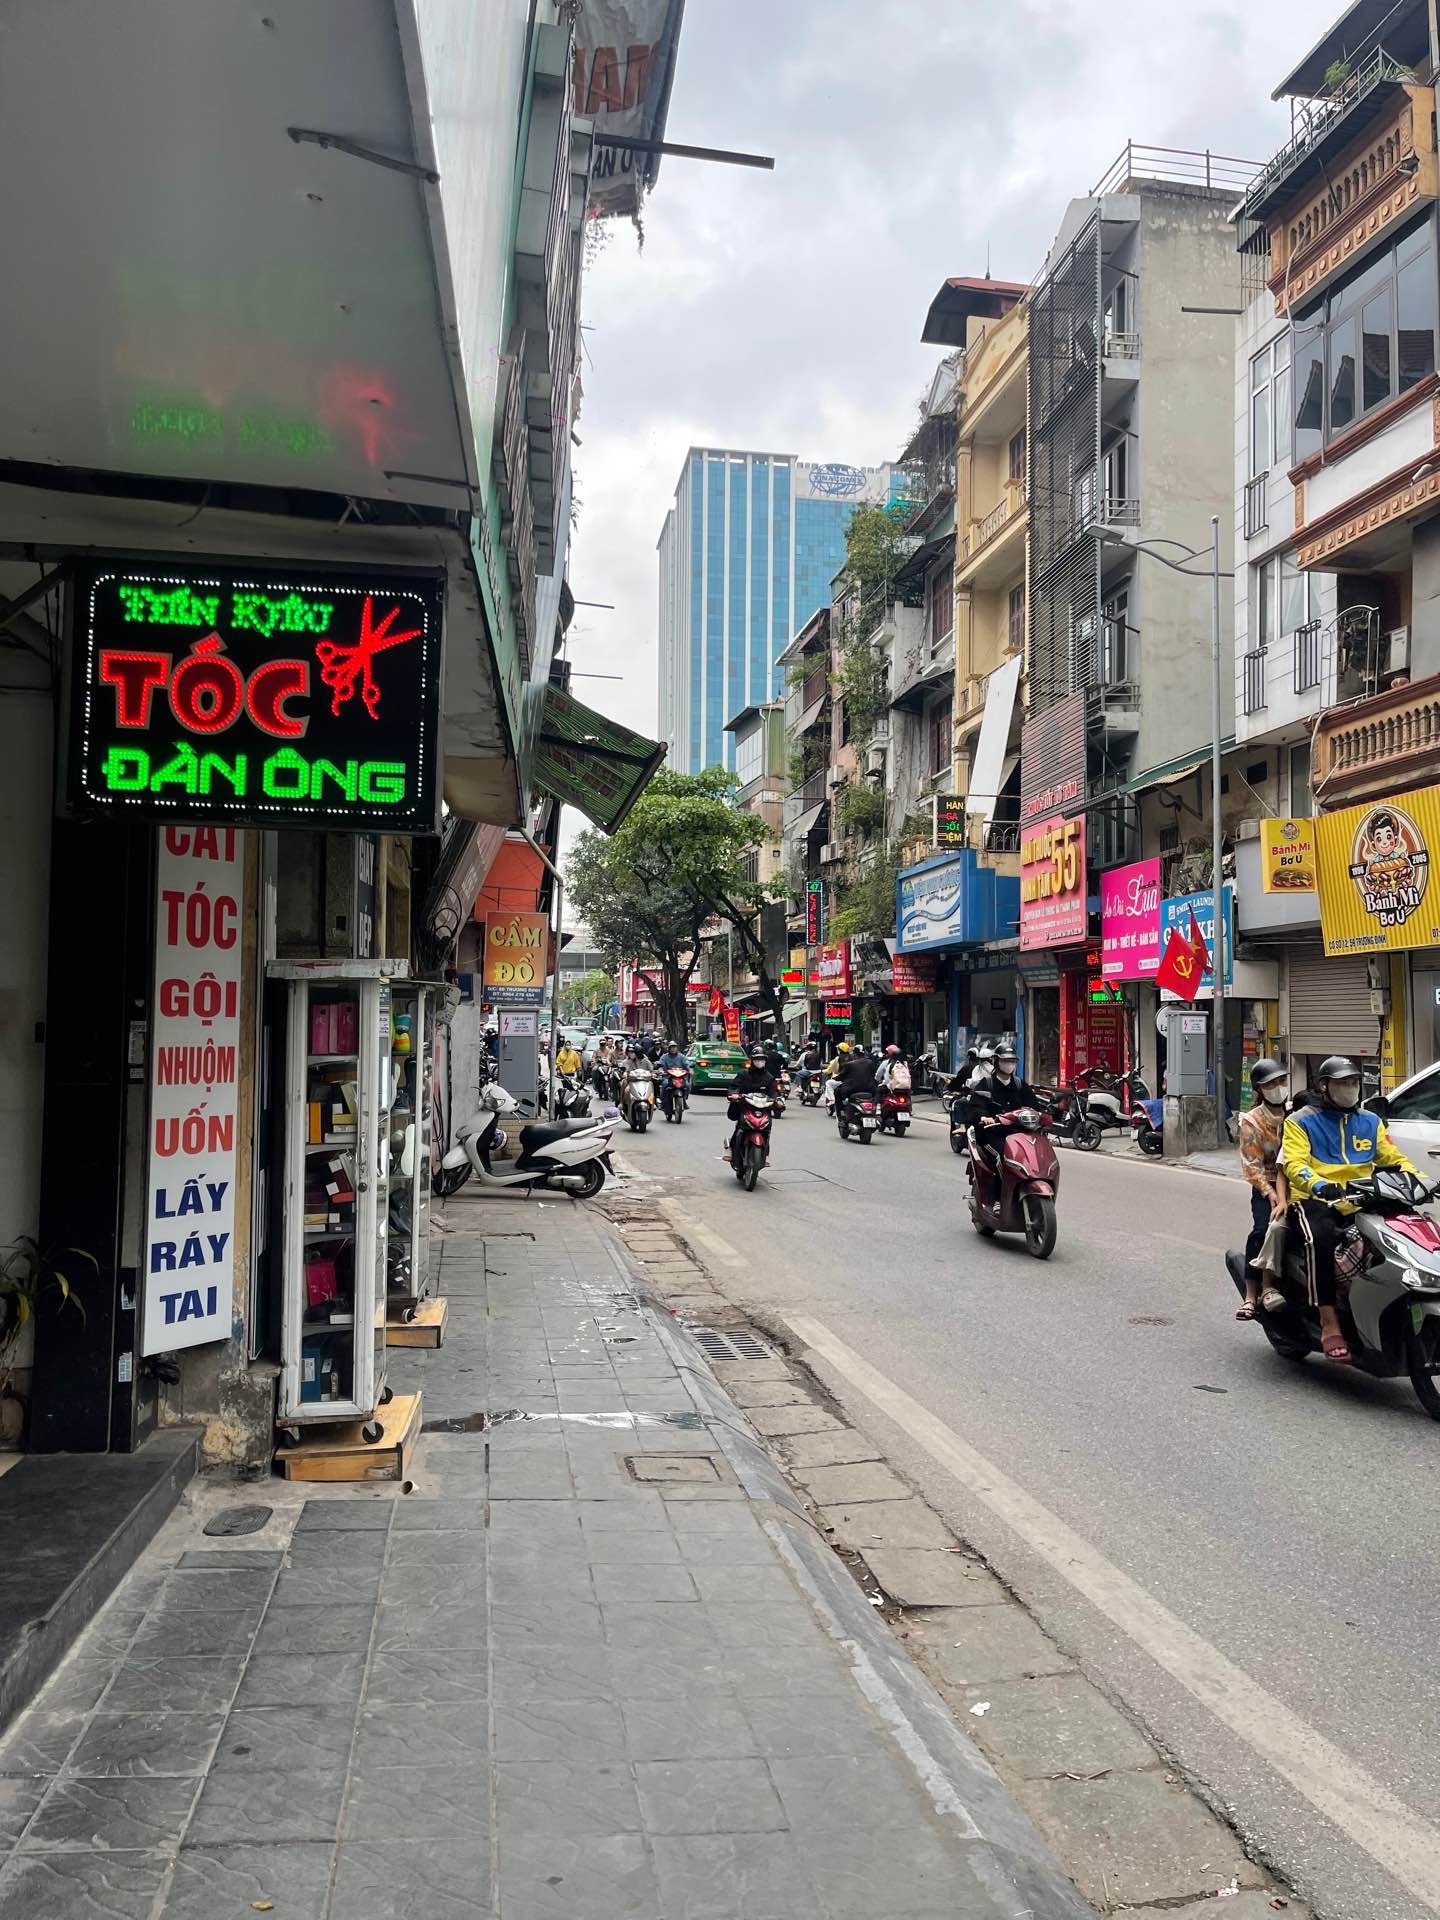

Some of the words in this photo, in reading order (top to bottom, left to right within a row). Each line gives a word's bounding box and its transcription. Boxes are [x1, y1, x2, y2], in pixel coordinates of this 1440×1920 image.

[99, 630, 310, 739] TÓC
[102, 741, 247, 796] ĐÀN
[263, 748, 405, 803] ÔNG
[1052, 821, 1081, 894] 55
[1272, 843, 1297, 855] Bánh
[1280, 855, 1294, 866] Bơ
[1412, 853, 1427, 864] 2005
[162, 882, 237, 950] TÓC
[1126, 874, 1158, 919] Lụa
[1193, 896, 1214, 907] LAUND
[1365, 889, 1398, 913] Bánh
[1399, 886, 1420, 908] Mì
[1379, 912, 1396, 926] Bơ
[1396, 905, 1406, 924] Ú
[490, 916, 541, 948] CẦM
[493, 953, 534, 983] ĐỒ
[160, 972, 237, 1026] GỘI
[157, 1038, 235, 1092] NHUỘM
[155, 1102, 233, 1158] UỐN
[1352, 1136, 1372, 1152] be
[154, 1173, 229, 1220] LẤY
[150, 1230, 230, 1274] RÁY
[159, 1286, 217, 1325] TAI
